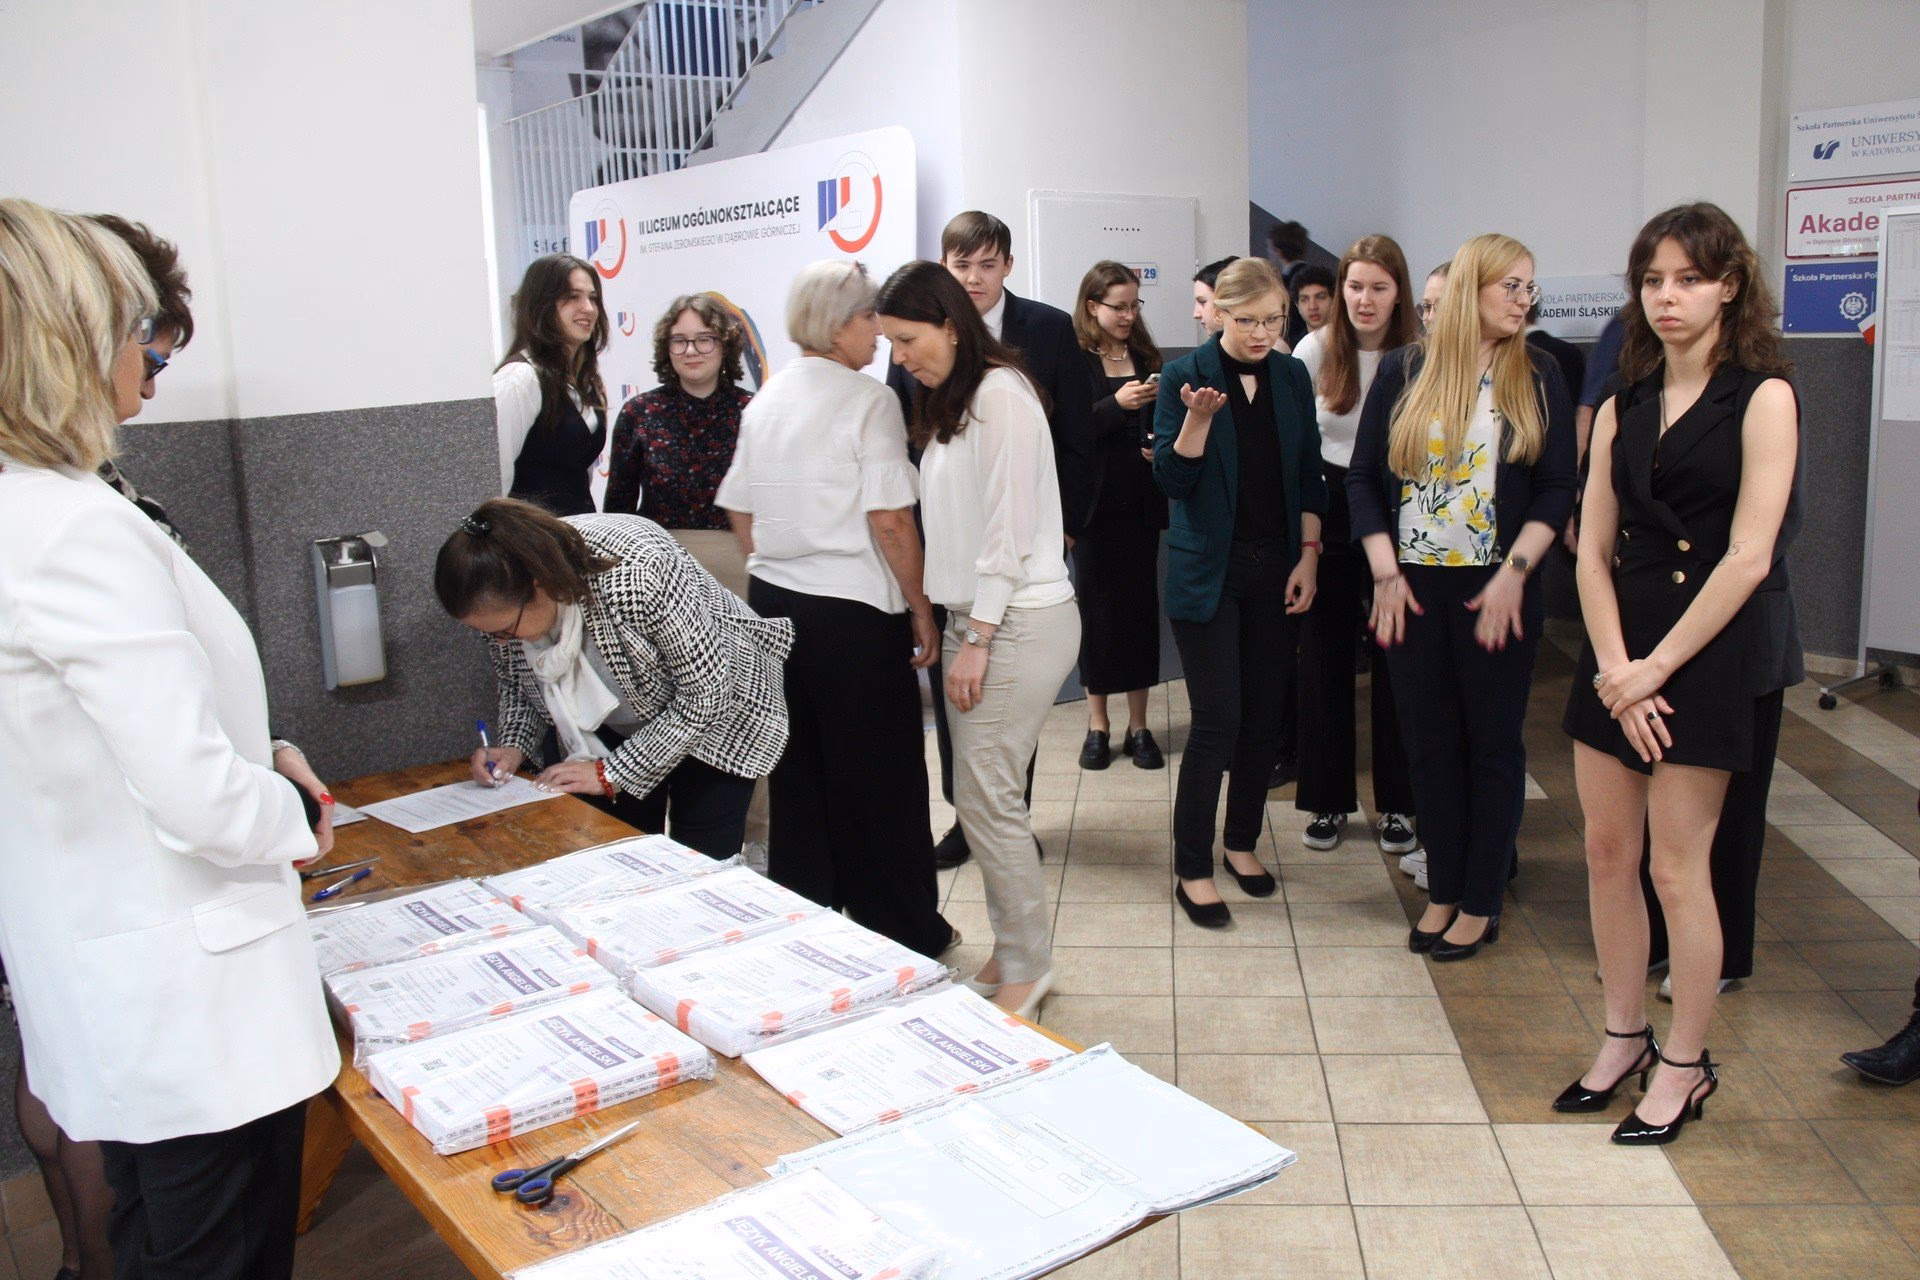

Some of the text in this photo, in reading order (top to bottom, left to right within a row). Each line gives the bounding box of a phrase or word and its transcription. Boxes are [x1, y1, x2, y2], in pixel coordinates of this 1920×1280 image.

[1797, 123, 1821, 131] Szkoła
[1823, 120, 1861, 128] Partnerska
[1864, 113, 1915, 125] Uniwersytetu
[1848, 196, 1883, 204] SZKOŁA
[639, 195, 799, 235] II LICEUM OGÓLNOKSZTAŁCĄCE
[1799, 211, 1879, 234] Akade
[649, 242, 673, 253] STEFANA
[717, 234, 723, 244] W
[725, 229, 759, 245] DĄBROWIE
[761, 223, 800, 239] GÓRNICZEJ
[1144, 268, 1156, 279] 29
[1792, 273, 1817, 281] Szkoła
[1819, 272, 1862, 280] Partnerska
[1540, 292, 1625, 304] KOŁA PARTNERSKA
[1536, 305, 1620, 319] KADEMII ŚLĄSKIE
[484, 952, 509, 970] JĘZYK
[500, 967, 538, 993] ANGIELSKI
[544, 1015, 618, 1066] JĘZYK ANGIELSKI
[907, 1020, 994, 1072] JĘZYK ANGIELSKI
[731, 1218, 768, 1248] JĘZYK
